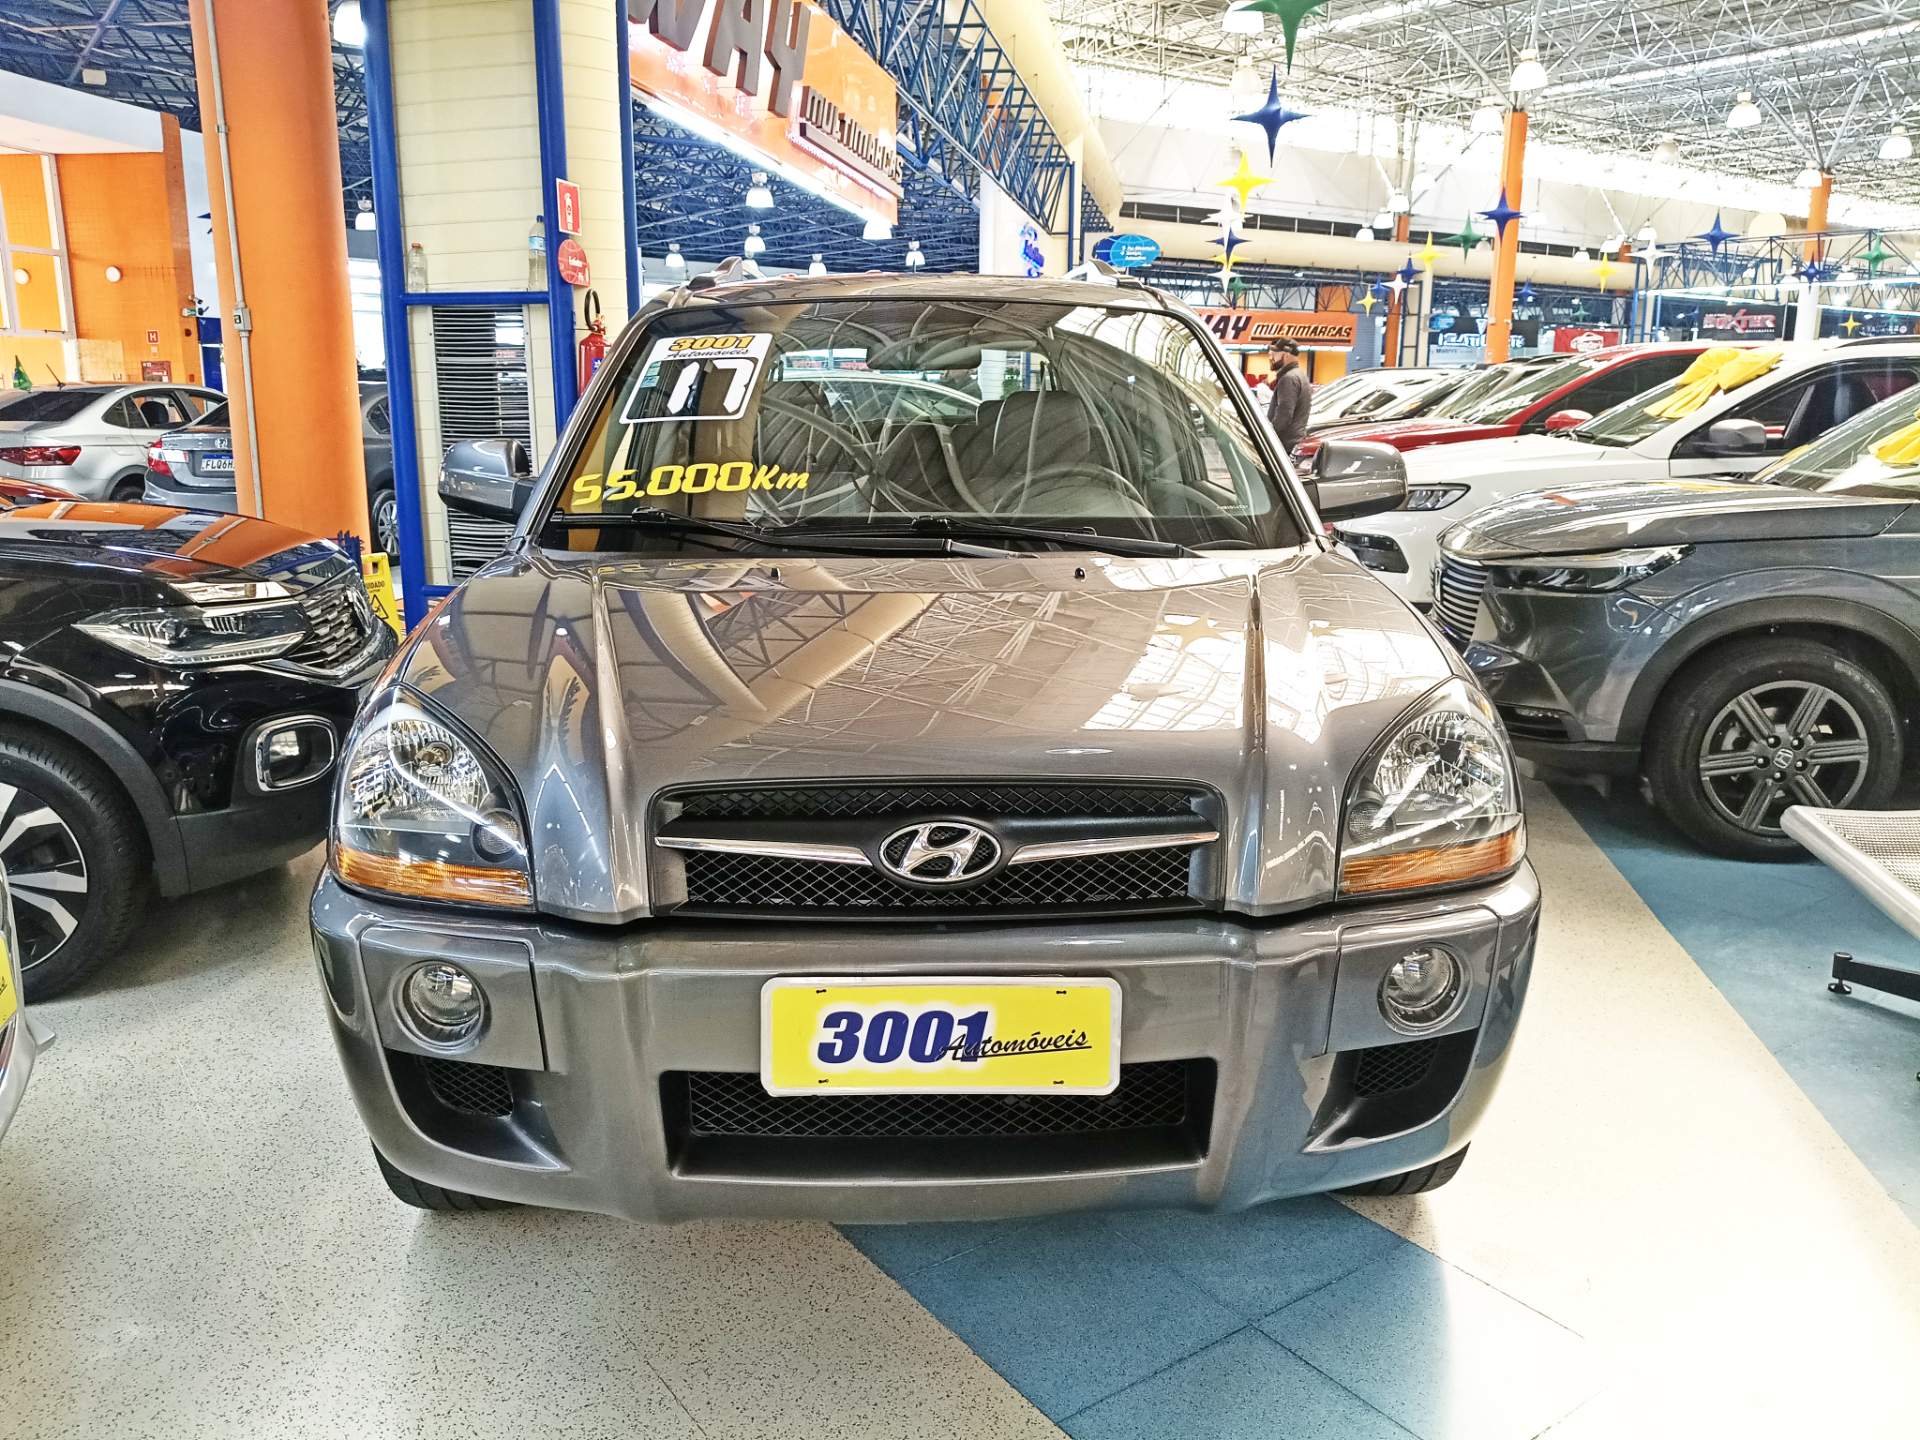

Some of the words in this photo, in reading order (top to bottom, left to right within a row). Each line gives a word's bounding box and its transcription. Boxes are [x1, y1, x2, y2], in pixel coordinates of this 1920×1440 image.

[801, 86, 904, 183] MULTIMARCAS
[1253, 324, 1352, 337] MULTIMARCAS
[670, 336, 755, 351] 3001
[366, 581, 385, 589] UIDADO
[817, 1010, 989, 1064] 3001
[935, 1028, 1092, 1061] Automóveis
